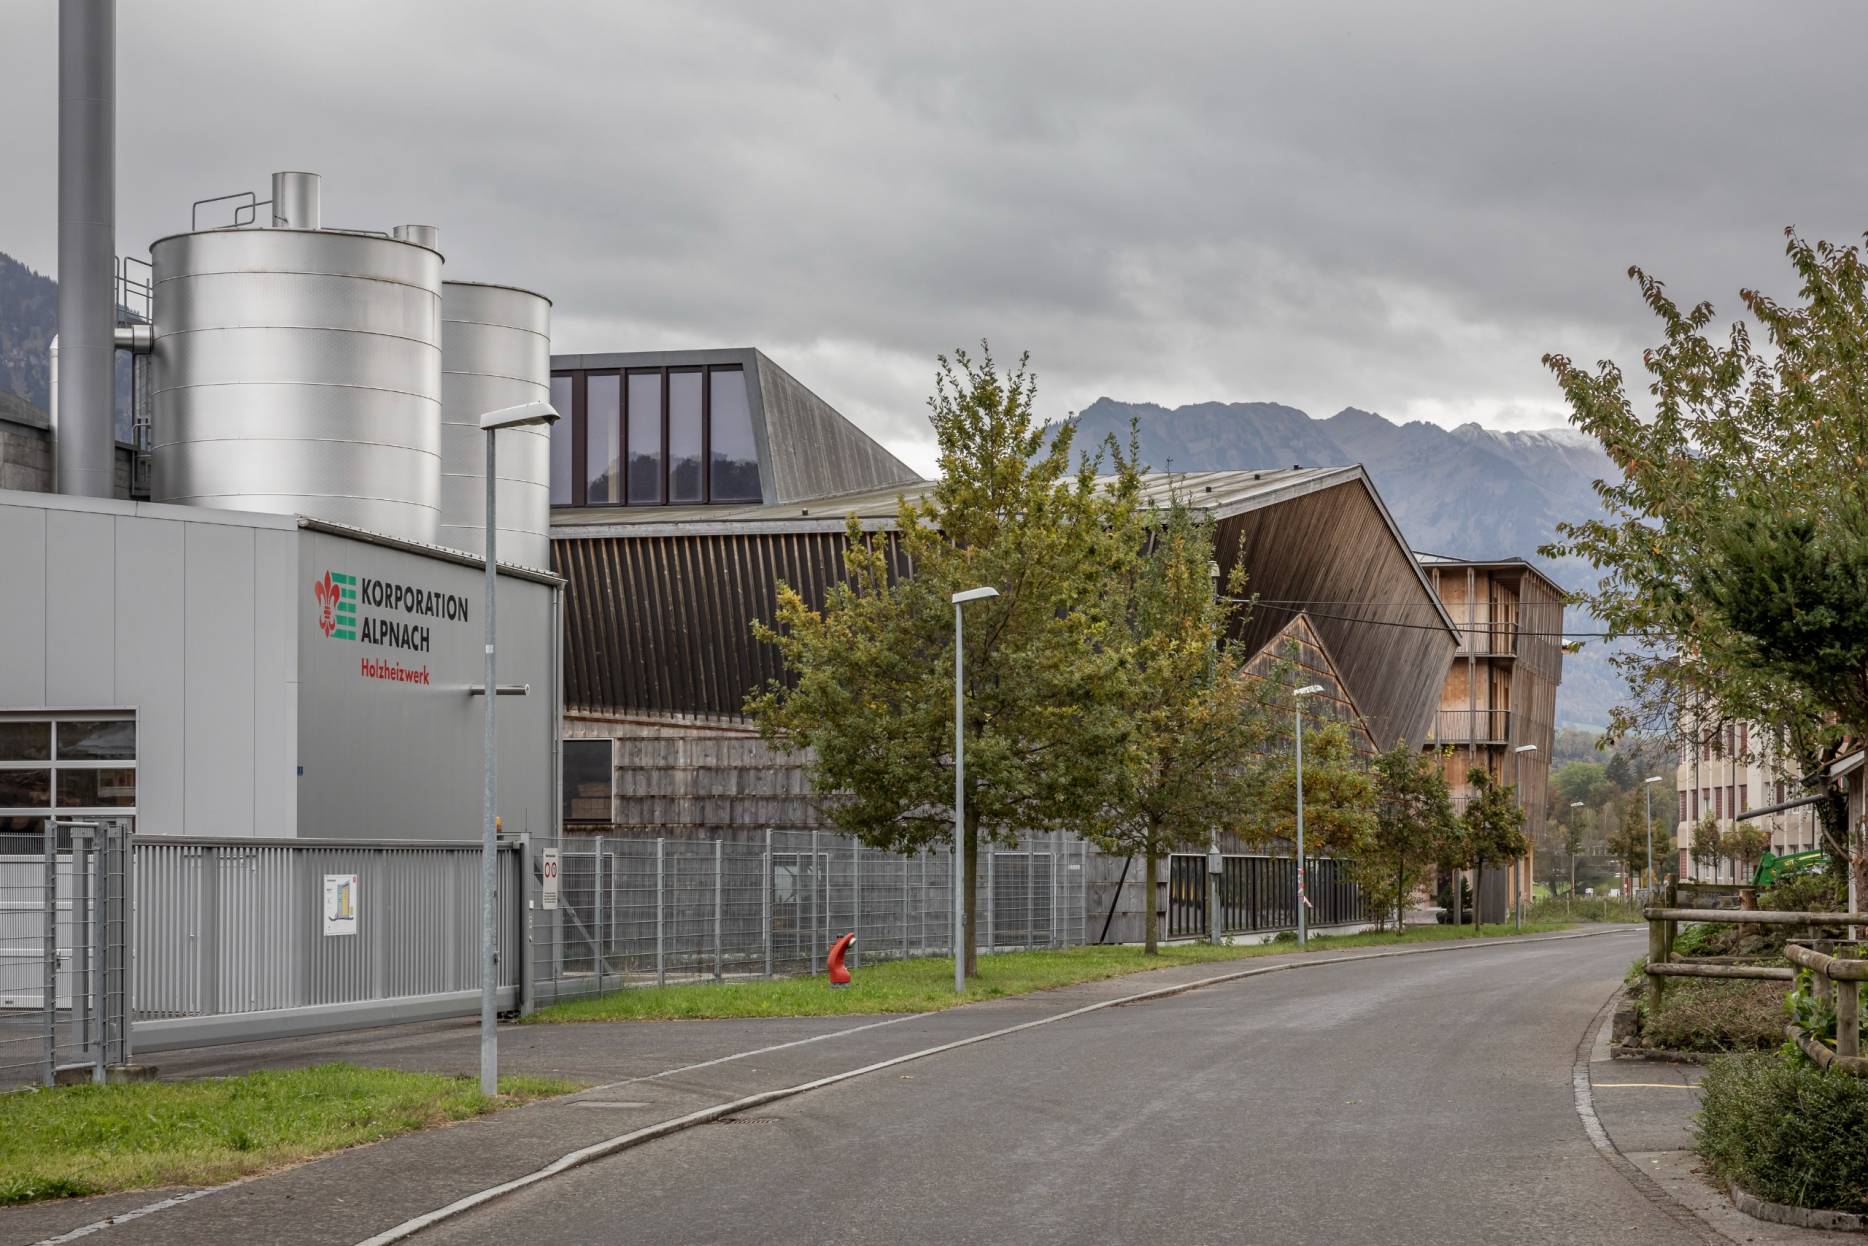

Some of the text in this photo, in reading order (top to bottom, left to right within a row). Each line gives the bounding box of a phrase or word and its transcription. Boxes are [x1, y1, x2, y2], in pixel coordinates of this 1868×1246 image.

[361, 578, 468, 622] KORPORATION
[361, 617, 430, 652] ALPNACH
[361, 657, 430, 685] Holzheizwerk
